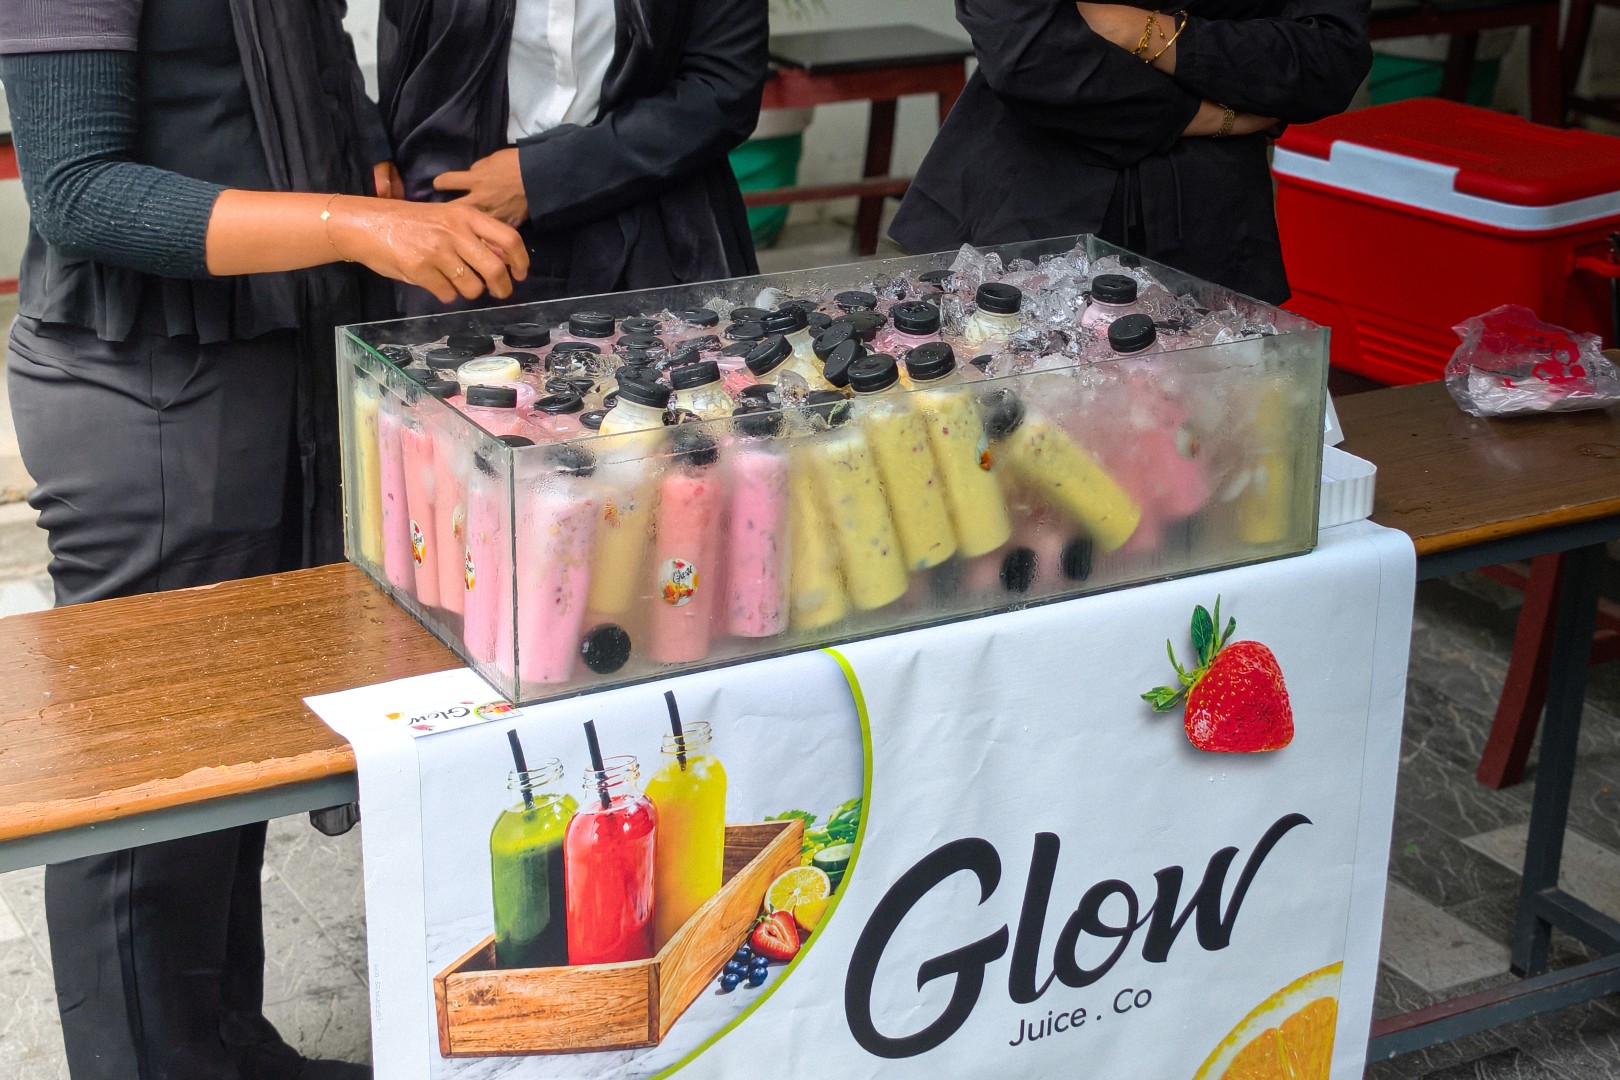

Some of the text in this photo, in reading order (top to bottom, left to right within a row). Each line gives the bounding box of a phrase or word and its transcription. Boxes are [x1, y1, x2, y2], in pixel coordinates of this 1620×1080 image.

[408, 707, 471, 727] Glow
[845, 813, 1313, 1059] Glow
[1008, 1009, 1087, 1047] Juice
[1113, 988, 1152, 1014] Co
